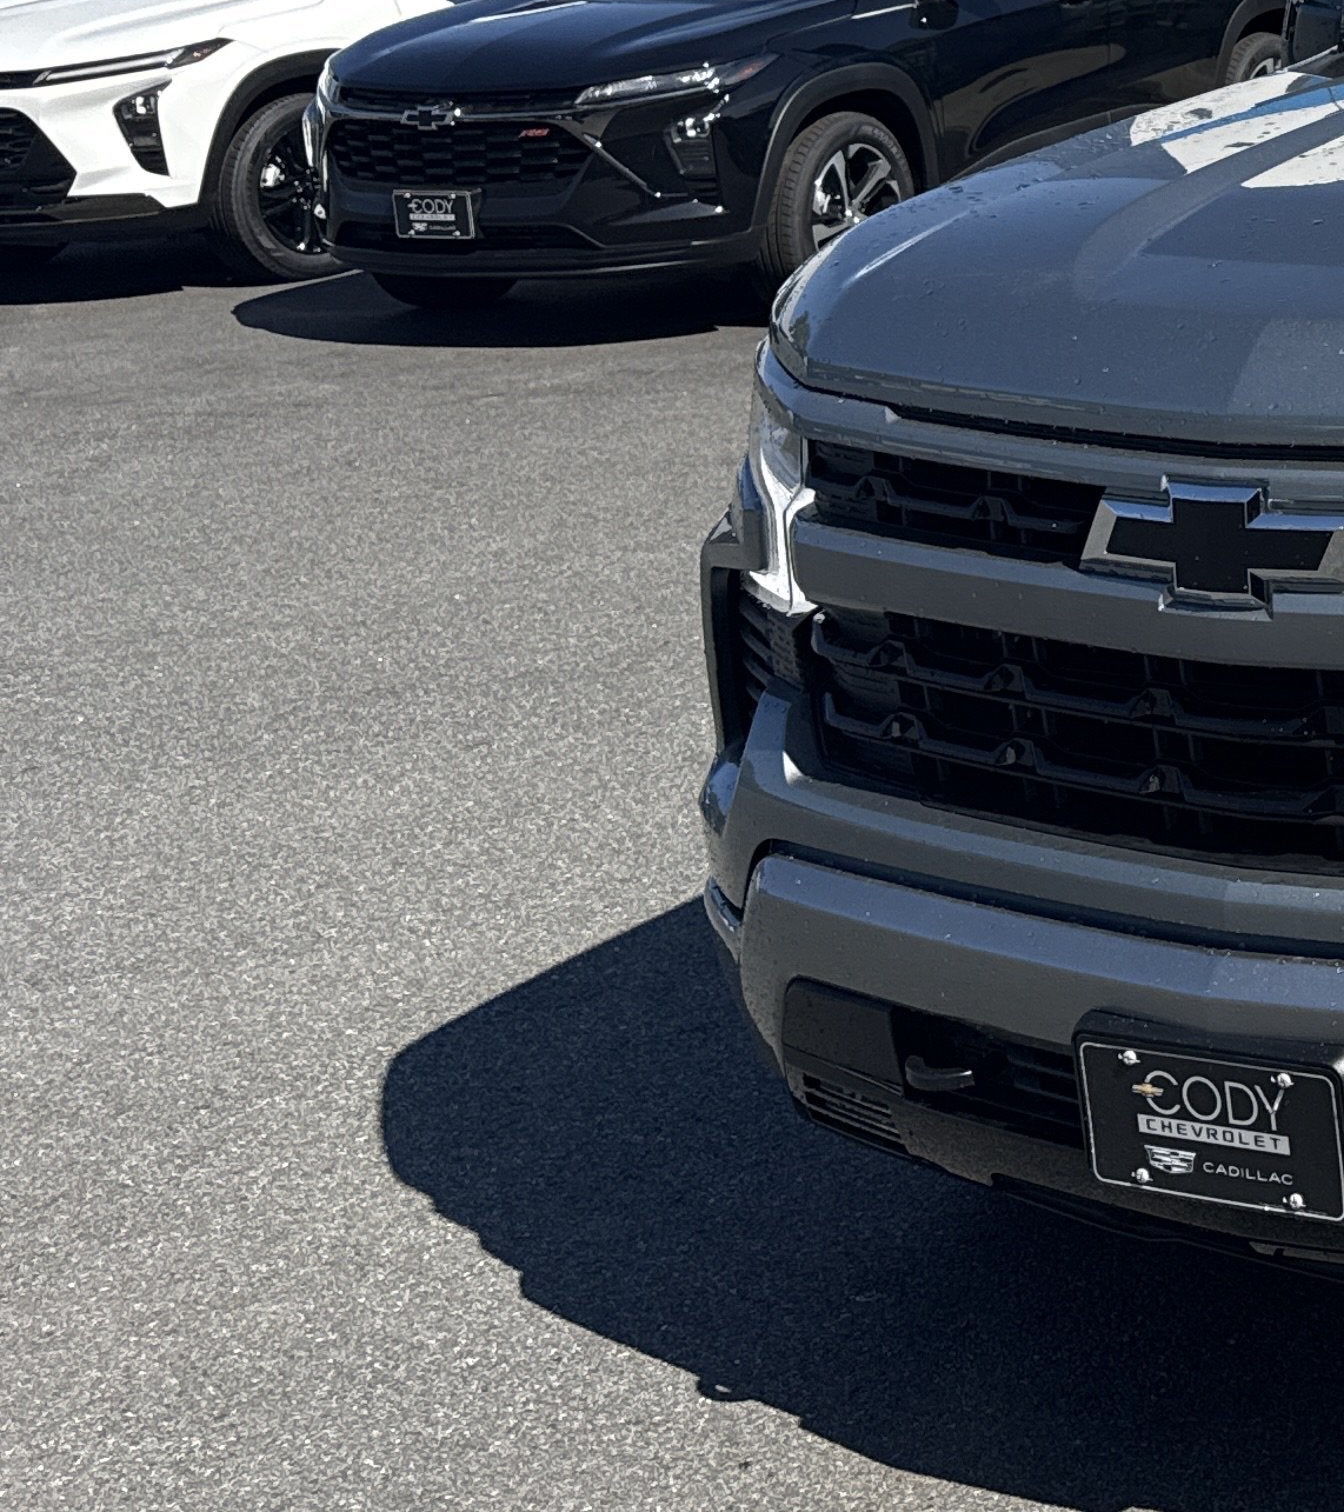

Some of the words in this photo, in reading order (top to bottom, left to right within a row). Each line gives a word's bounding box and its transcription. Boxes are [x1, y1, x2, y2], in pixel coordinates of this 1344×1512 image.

[411, 198, 454, 214] CODY
[1143, 1069, 1286, 1132] CODY
[1145, 1117, 1282, 1151] CHEVROLET
[1202, 1160, 1294, 1186] CADILLAC
